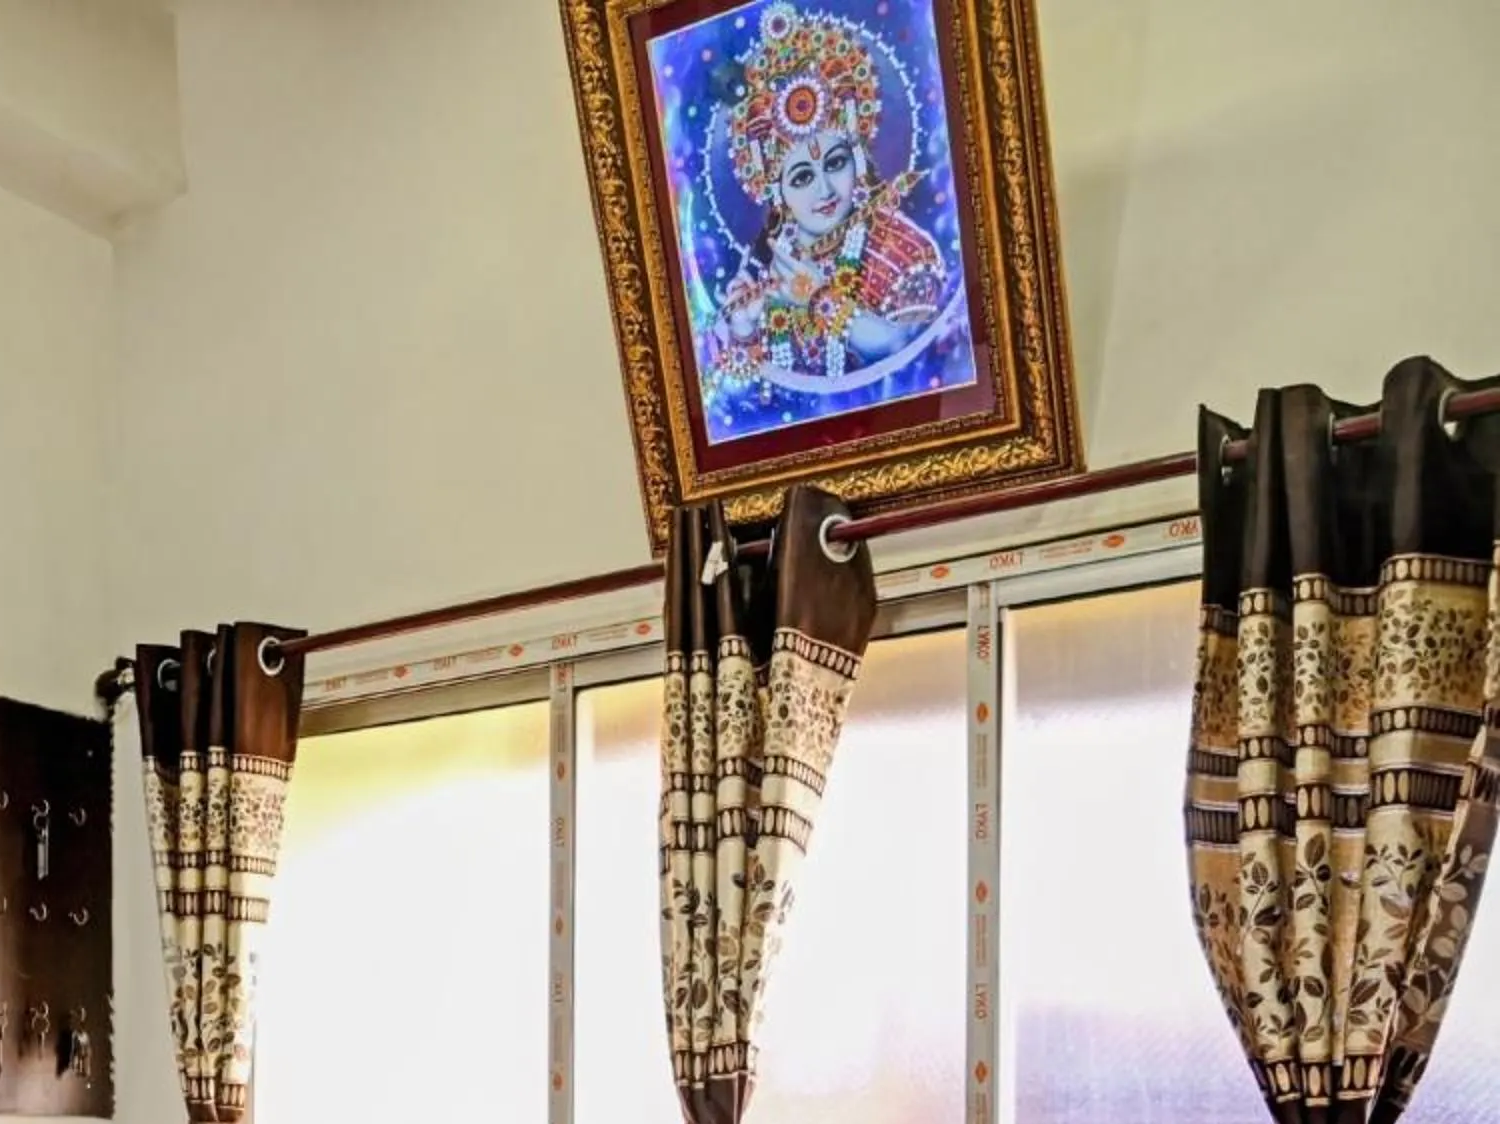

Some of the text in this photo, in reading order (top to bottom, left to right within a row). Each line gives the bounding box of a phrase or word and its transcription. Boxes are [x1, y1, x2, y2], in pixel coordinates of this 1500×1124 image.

[977, 625, 990, 660] LYKO
[976, 803, 990, 839] LYKO
[974, 983, 987, 1019] LYKO
